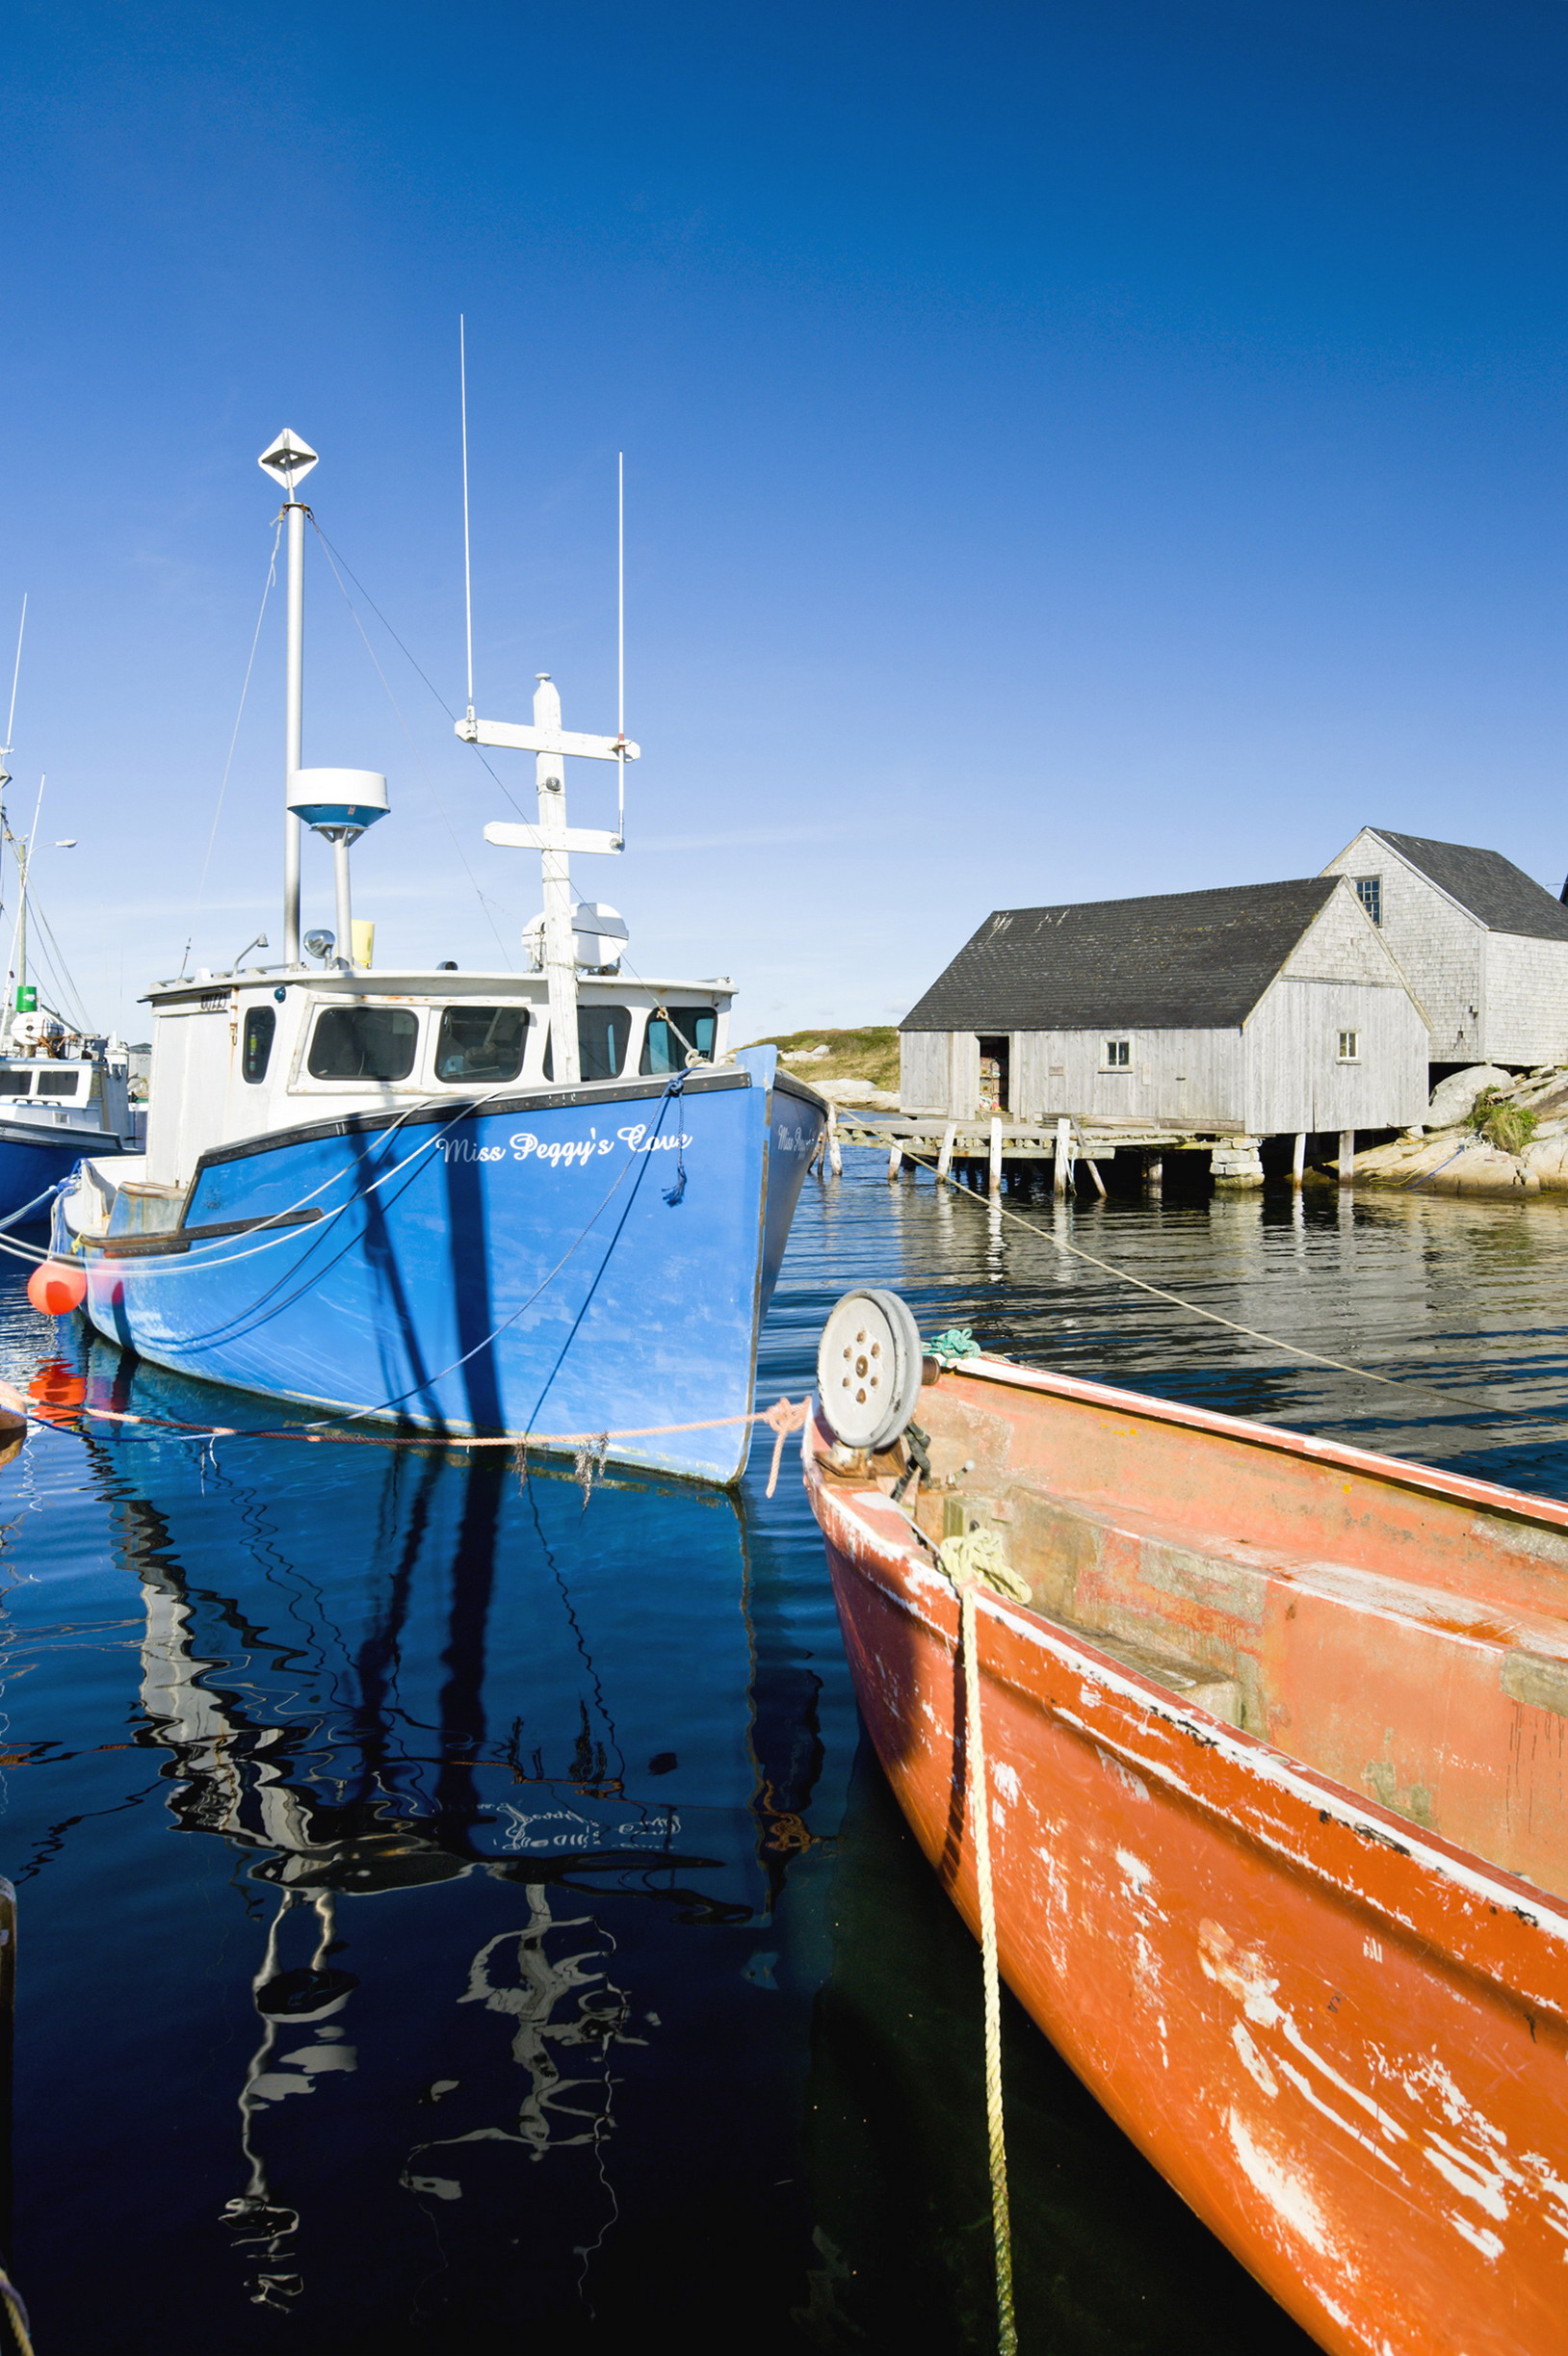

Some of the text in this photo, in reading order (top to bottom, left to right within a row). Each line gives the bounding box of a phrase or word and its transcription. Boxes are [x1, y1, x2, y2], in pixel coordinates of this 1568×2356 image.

[435, 1123, 693, 1168] Miss Peggy's Cove
